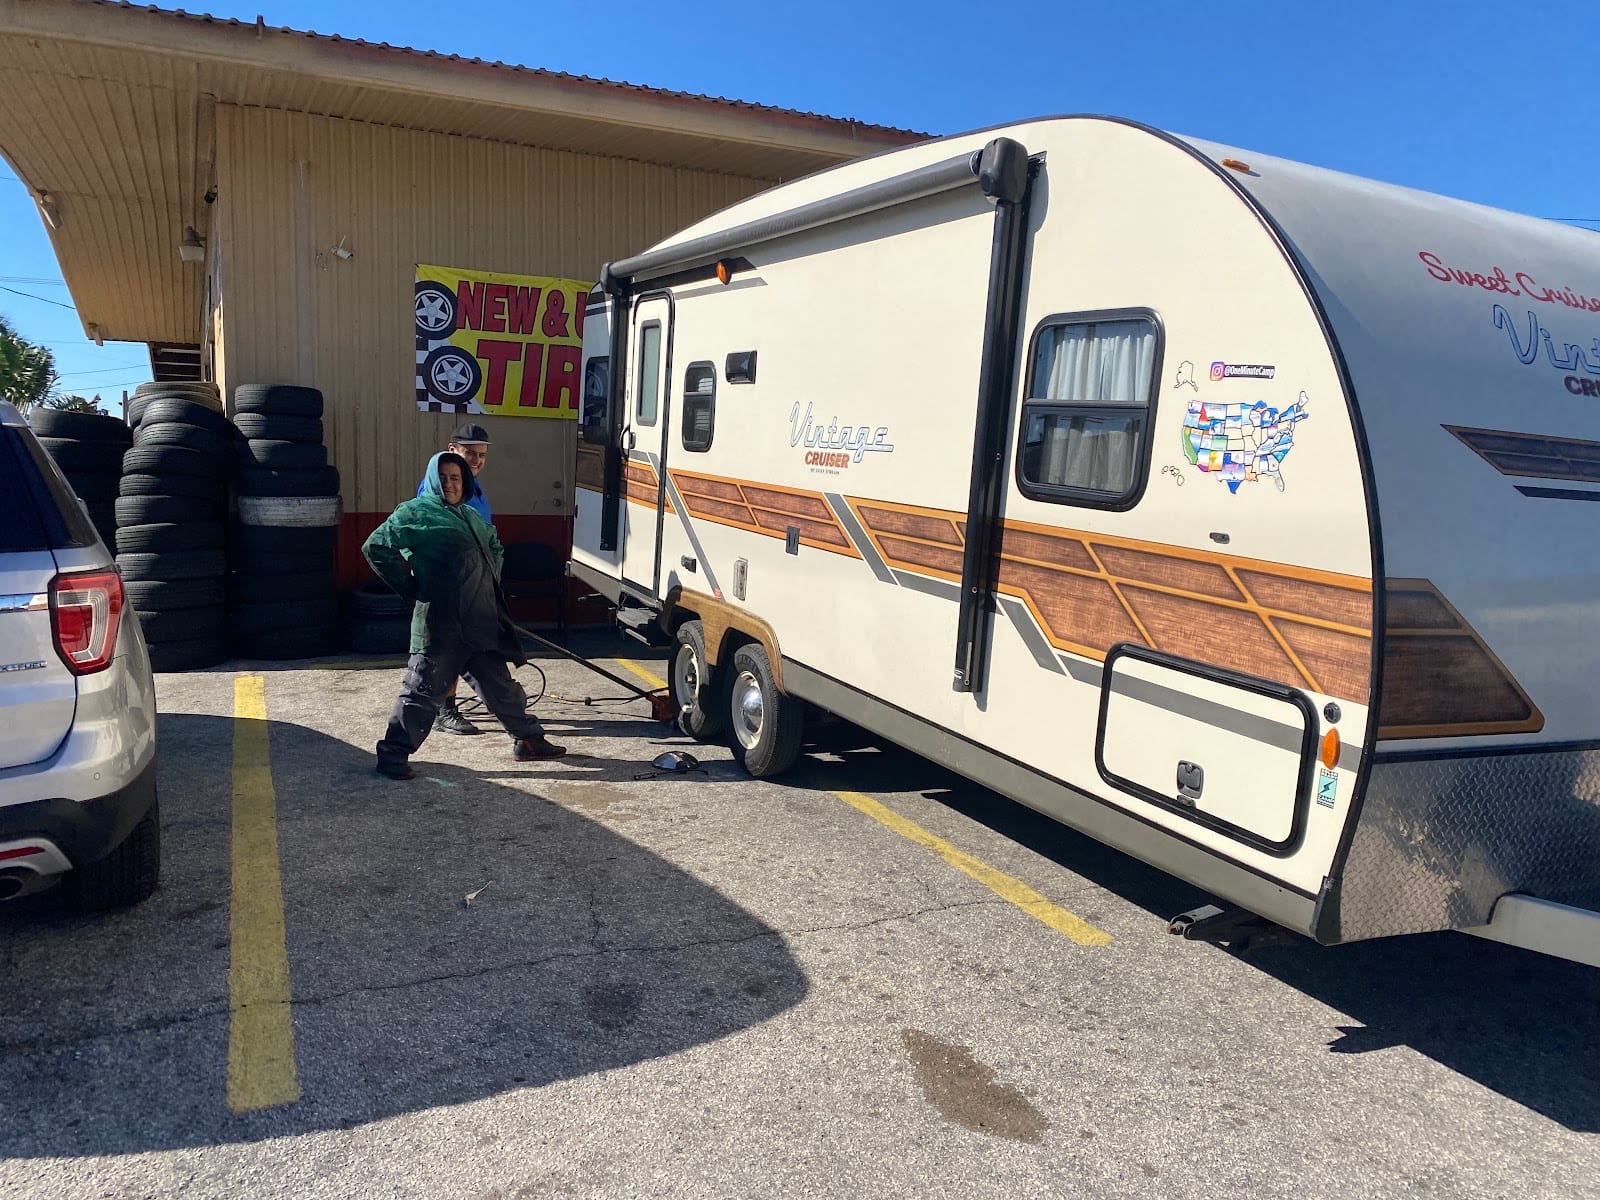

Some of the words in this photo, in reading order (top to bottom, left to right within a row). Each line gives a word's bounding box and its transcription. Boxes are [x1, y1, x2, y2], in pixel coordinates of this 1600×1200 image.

[1418, 251, 1521, 297] Sweet
[455, 280, 542, 335] NEW
[1563, 375, 1600, 398] CR
[789, 400, 895, 464] Vintage
[804, 450, 851, 469] CRUISER
